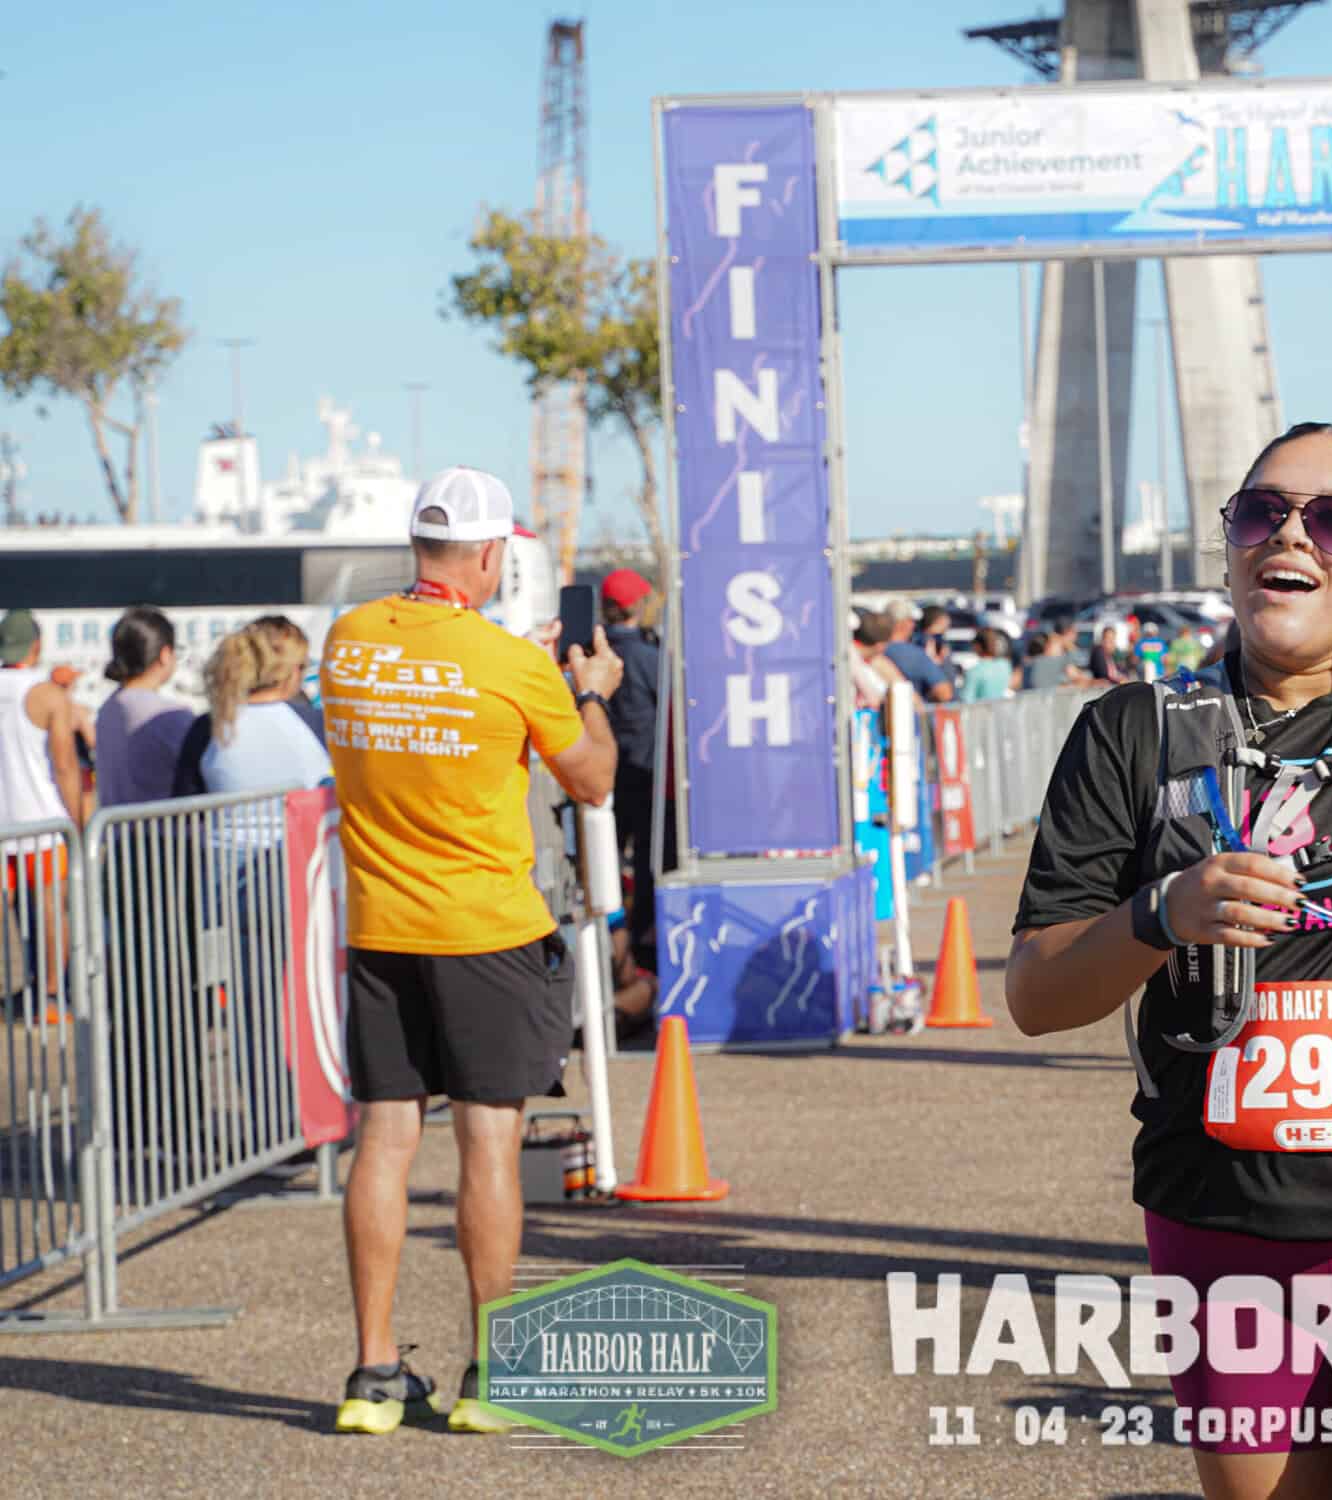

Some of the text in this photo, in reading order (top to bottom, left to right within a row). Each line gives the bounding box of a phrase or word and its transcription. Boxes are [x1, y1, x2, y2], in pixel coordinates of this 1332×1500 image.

[956, 126, 1042, 149] Junior
[957, 149, 1144, 175] Achievement
[714, 163, 791, 748] FINISH
[368, 722, 416, 738] WHAT
[419, 726, 437, 740] IT
[442, 728, 460, 743] IS
[374, 737, 404, 752] ALL
[1282, 989, 1322, 1021] HALF
